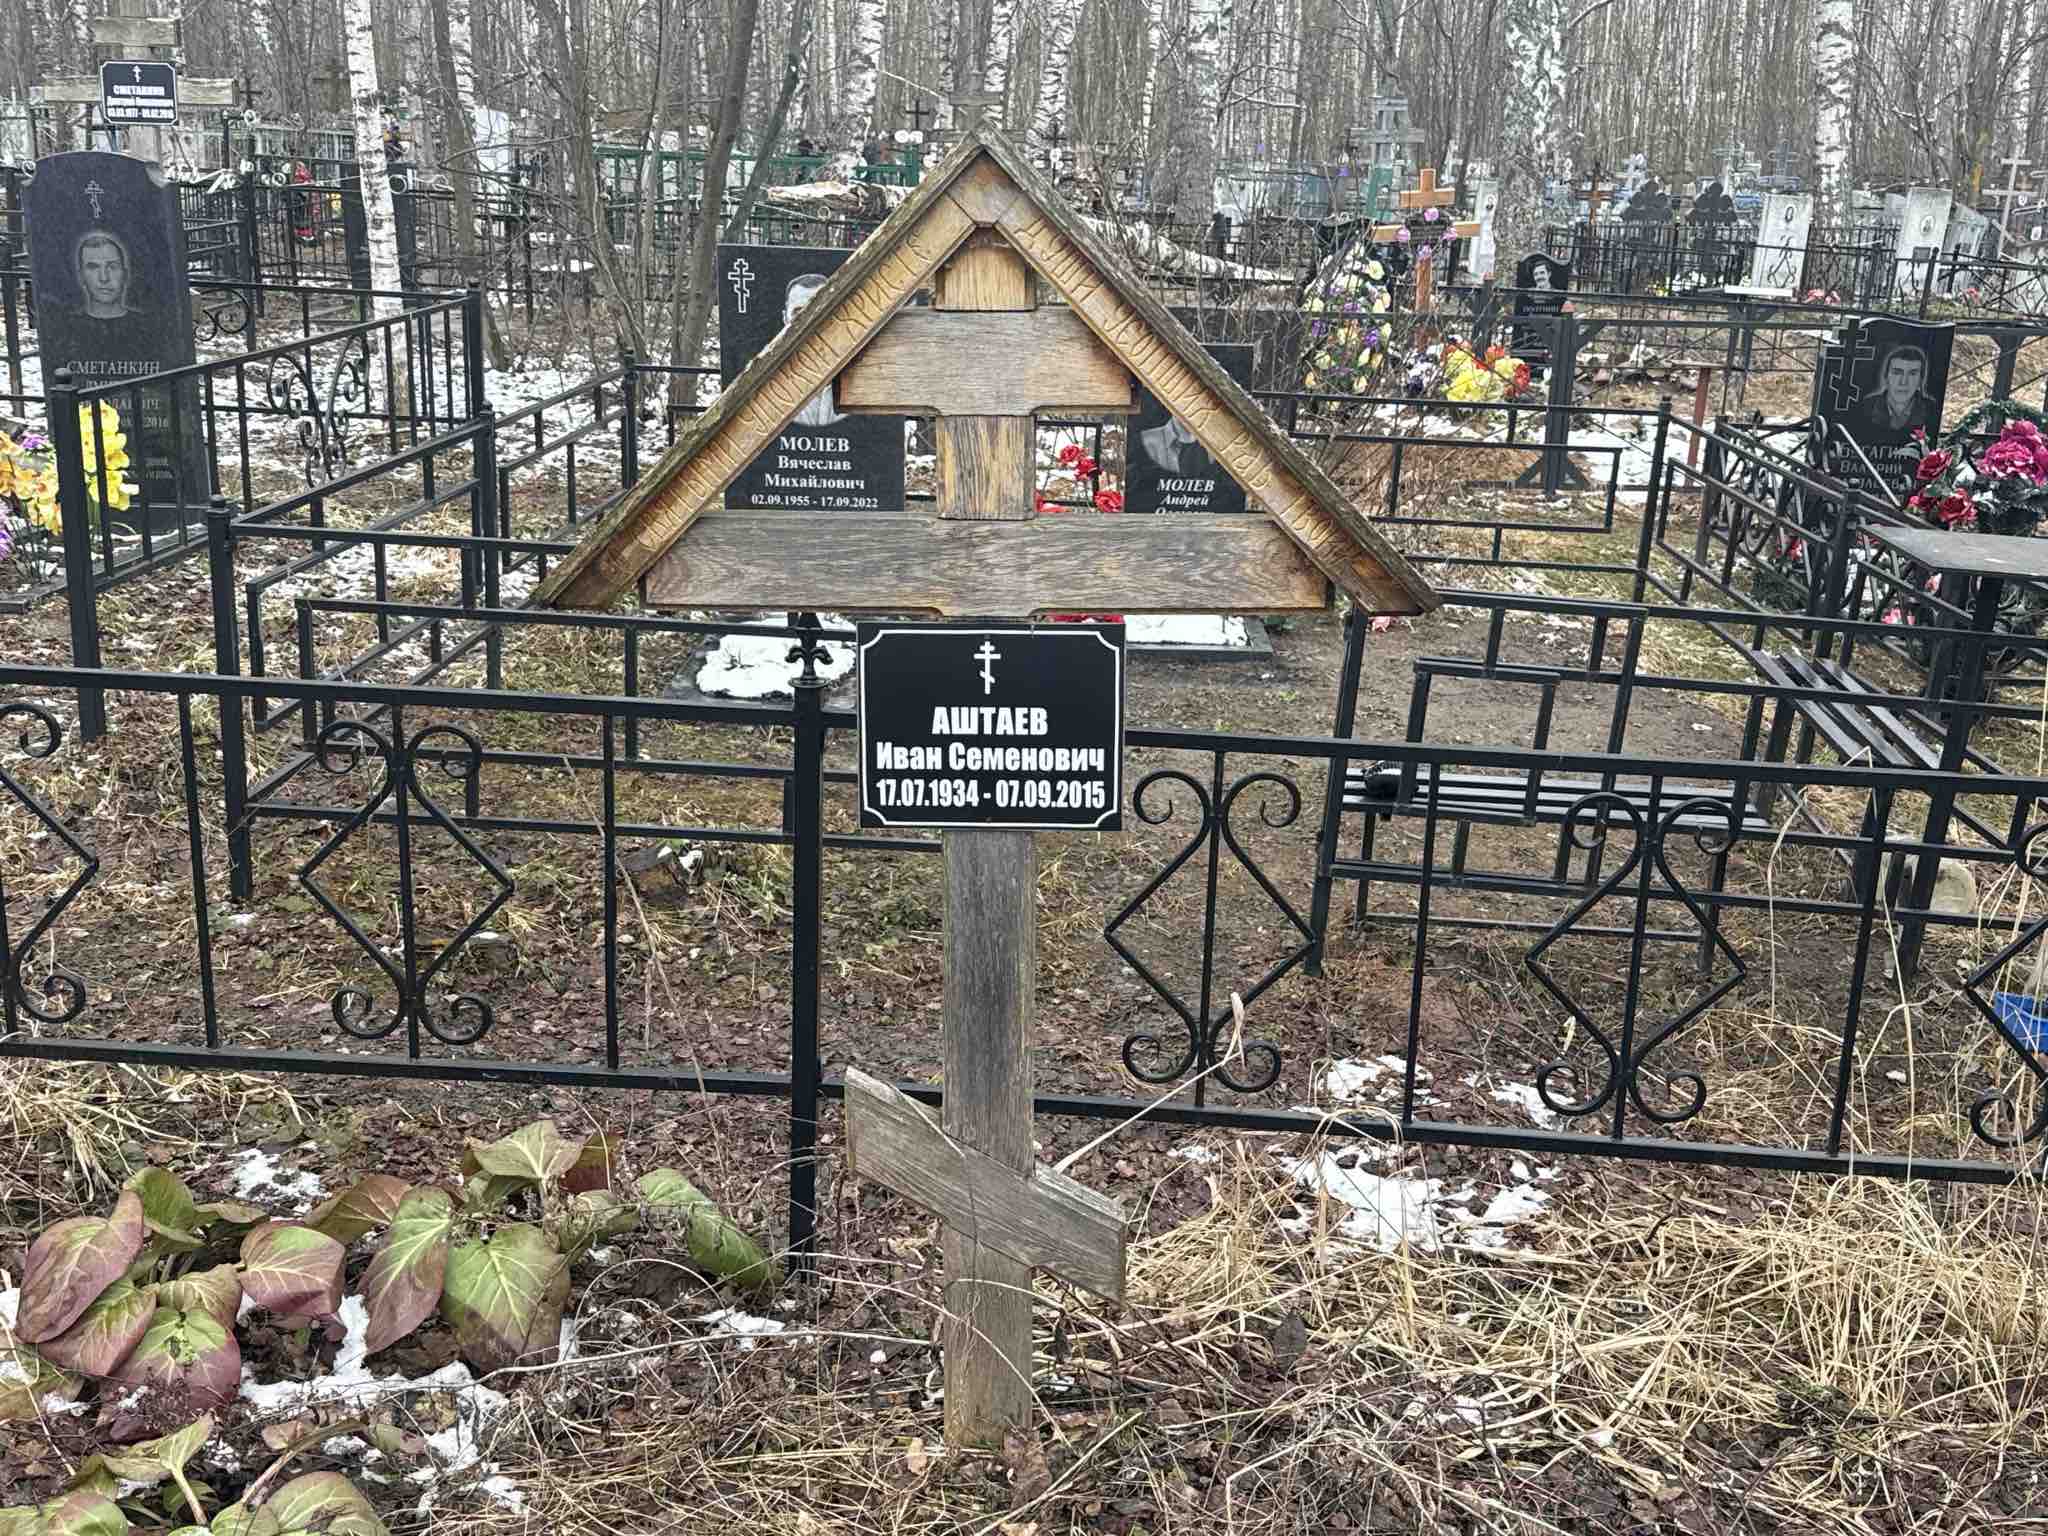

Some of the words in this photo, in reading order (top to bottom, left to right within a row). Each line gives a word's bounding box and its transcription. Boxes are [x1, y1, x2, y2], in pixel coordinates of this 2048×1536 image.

[67, 361, 159, 374] СМЕТАНКИН
[780, 437, 850, 452] МОЛЕВ
[778, 455, 852, 470] Вячеслав
[764, 473, 864, 489] Михайлович
[1157, 479, 1215, 492] МОЛЕВ
[752, 494, 809, 506] 02.09.1955
[821, 497, 878, 508] 17.09.2022
[1160, 494, 1208, 507] Андрей
[931, 707, 1048, 735] АШТАЕВ
[876, 742, 941, 770] Иван
[949, 742, 1105, 771] Семенович
[876, 779, 979, 807] 17.07.1934
[996, 780, 1105, 808] 07.09.2015
